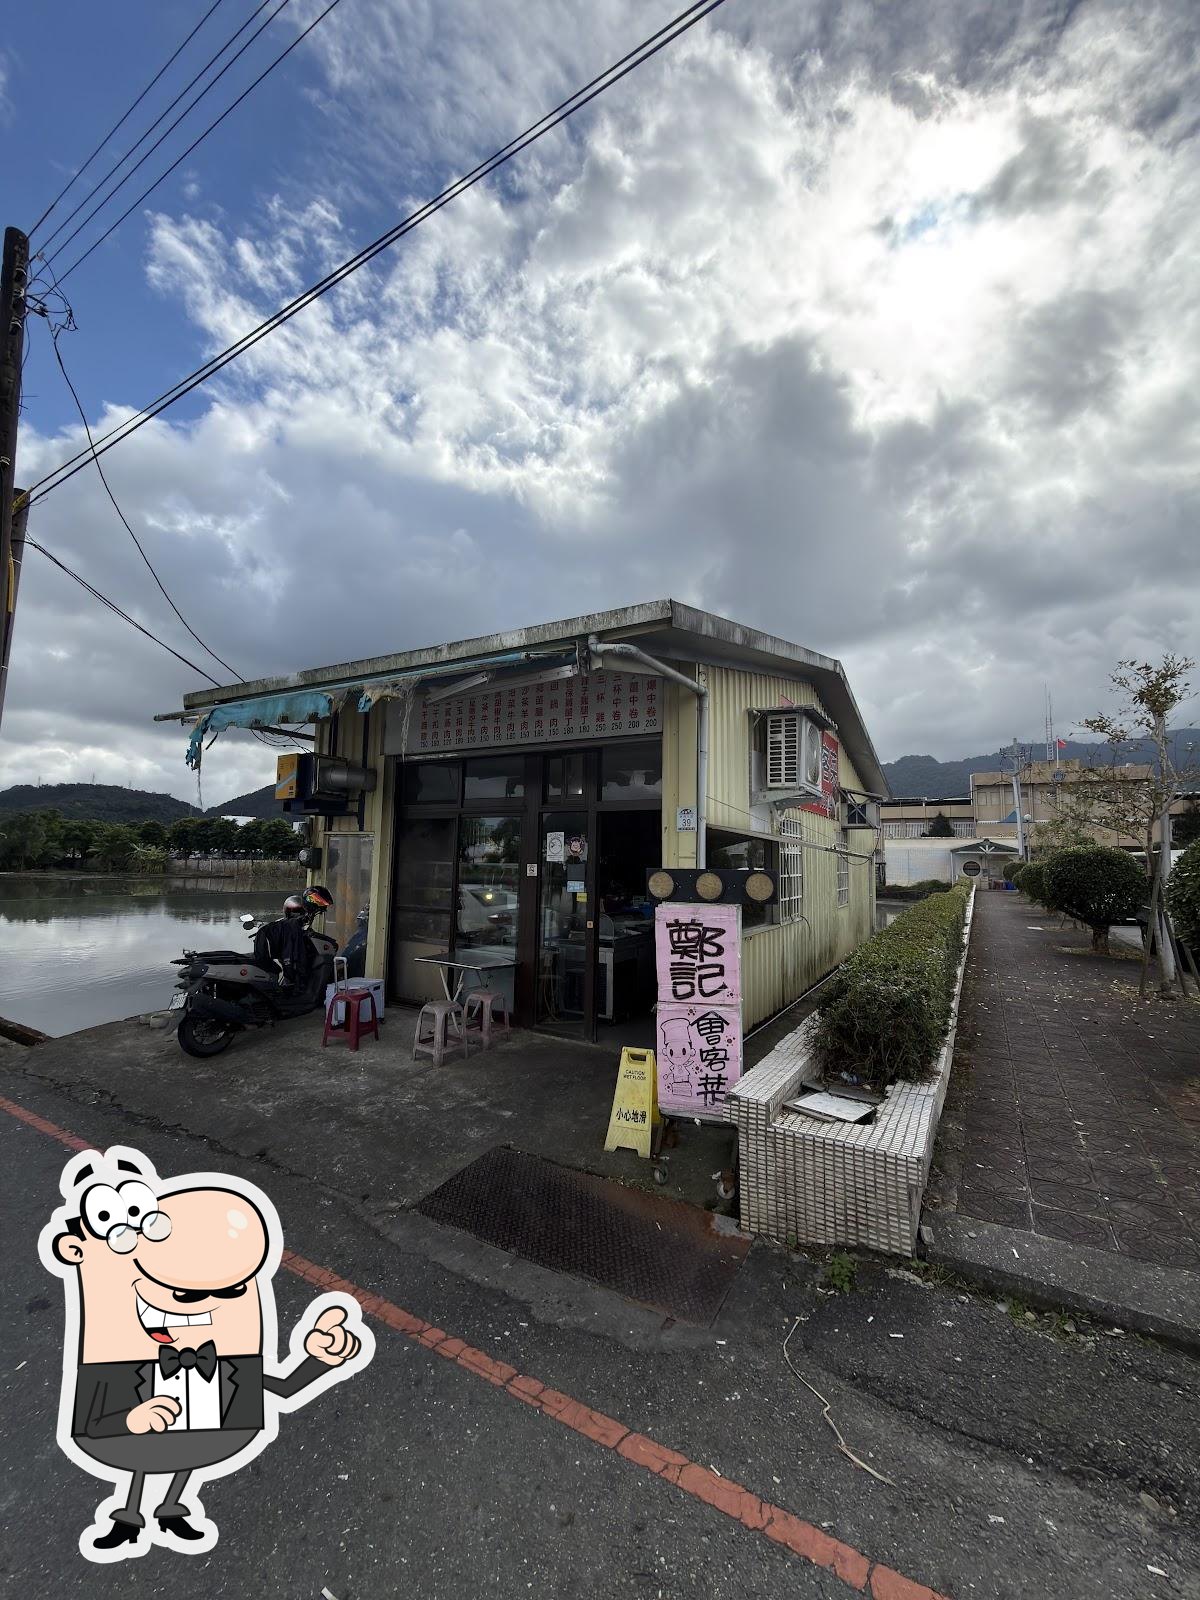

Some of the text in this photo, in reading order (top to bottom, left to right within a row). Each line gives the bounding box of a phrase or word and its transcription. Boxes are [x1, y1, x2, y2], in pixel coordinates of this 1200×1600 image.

[666, 918, 728, 1000] 鄭記
[616, 1107, 647, 1124] 小心地滑
